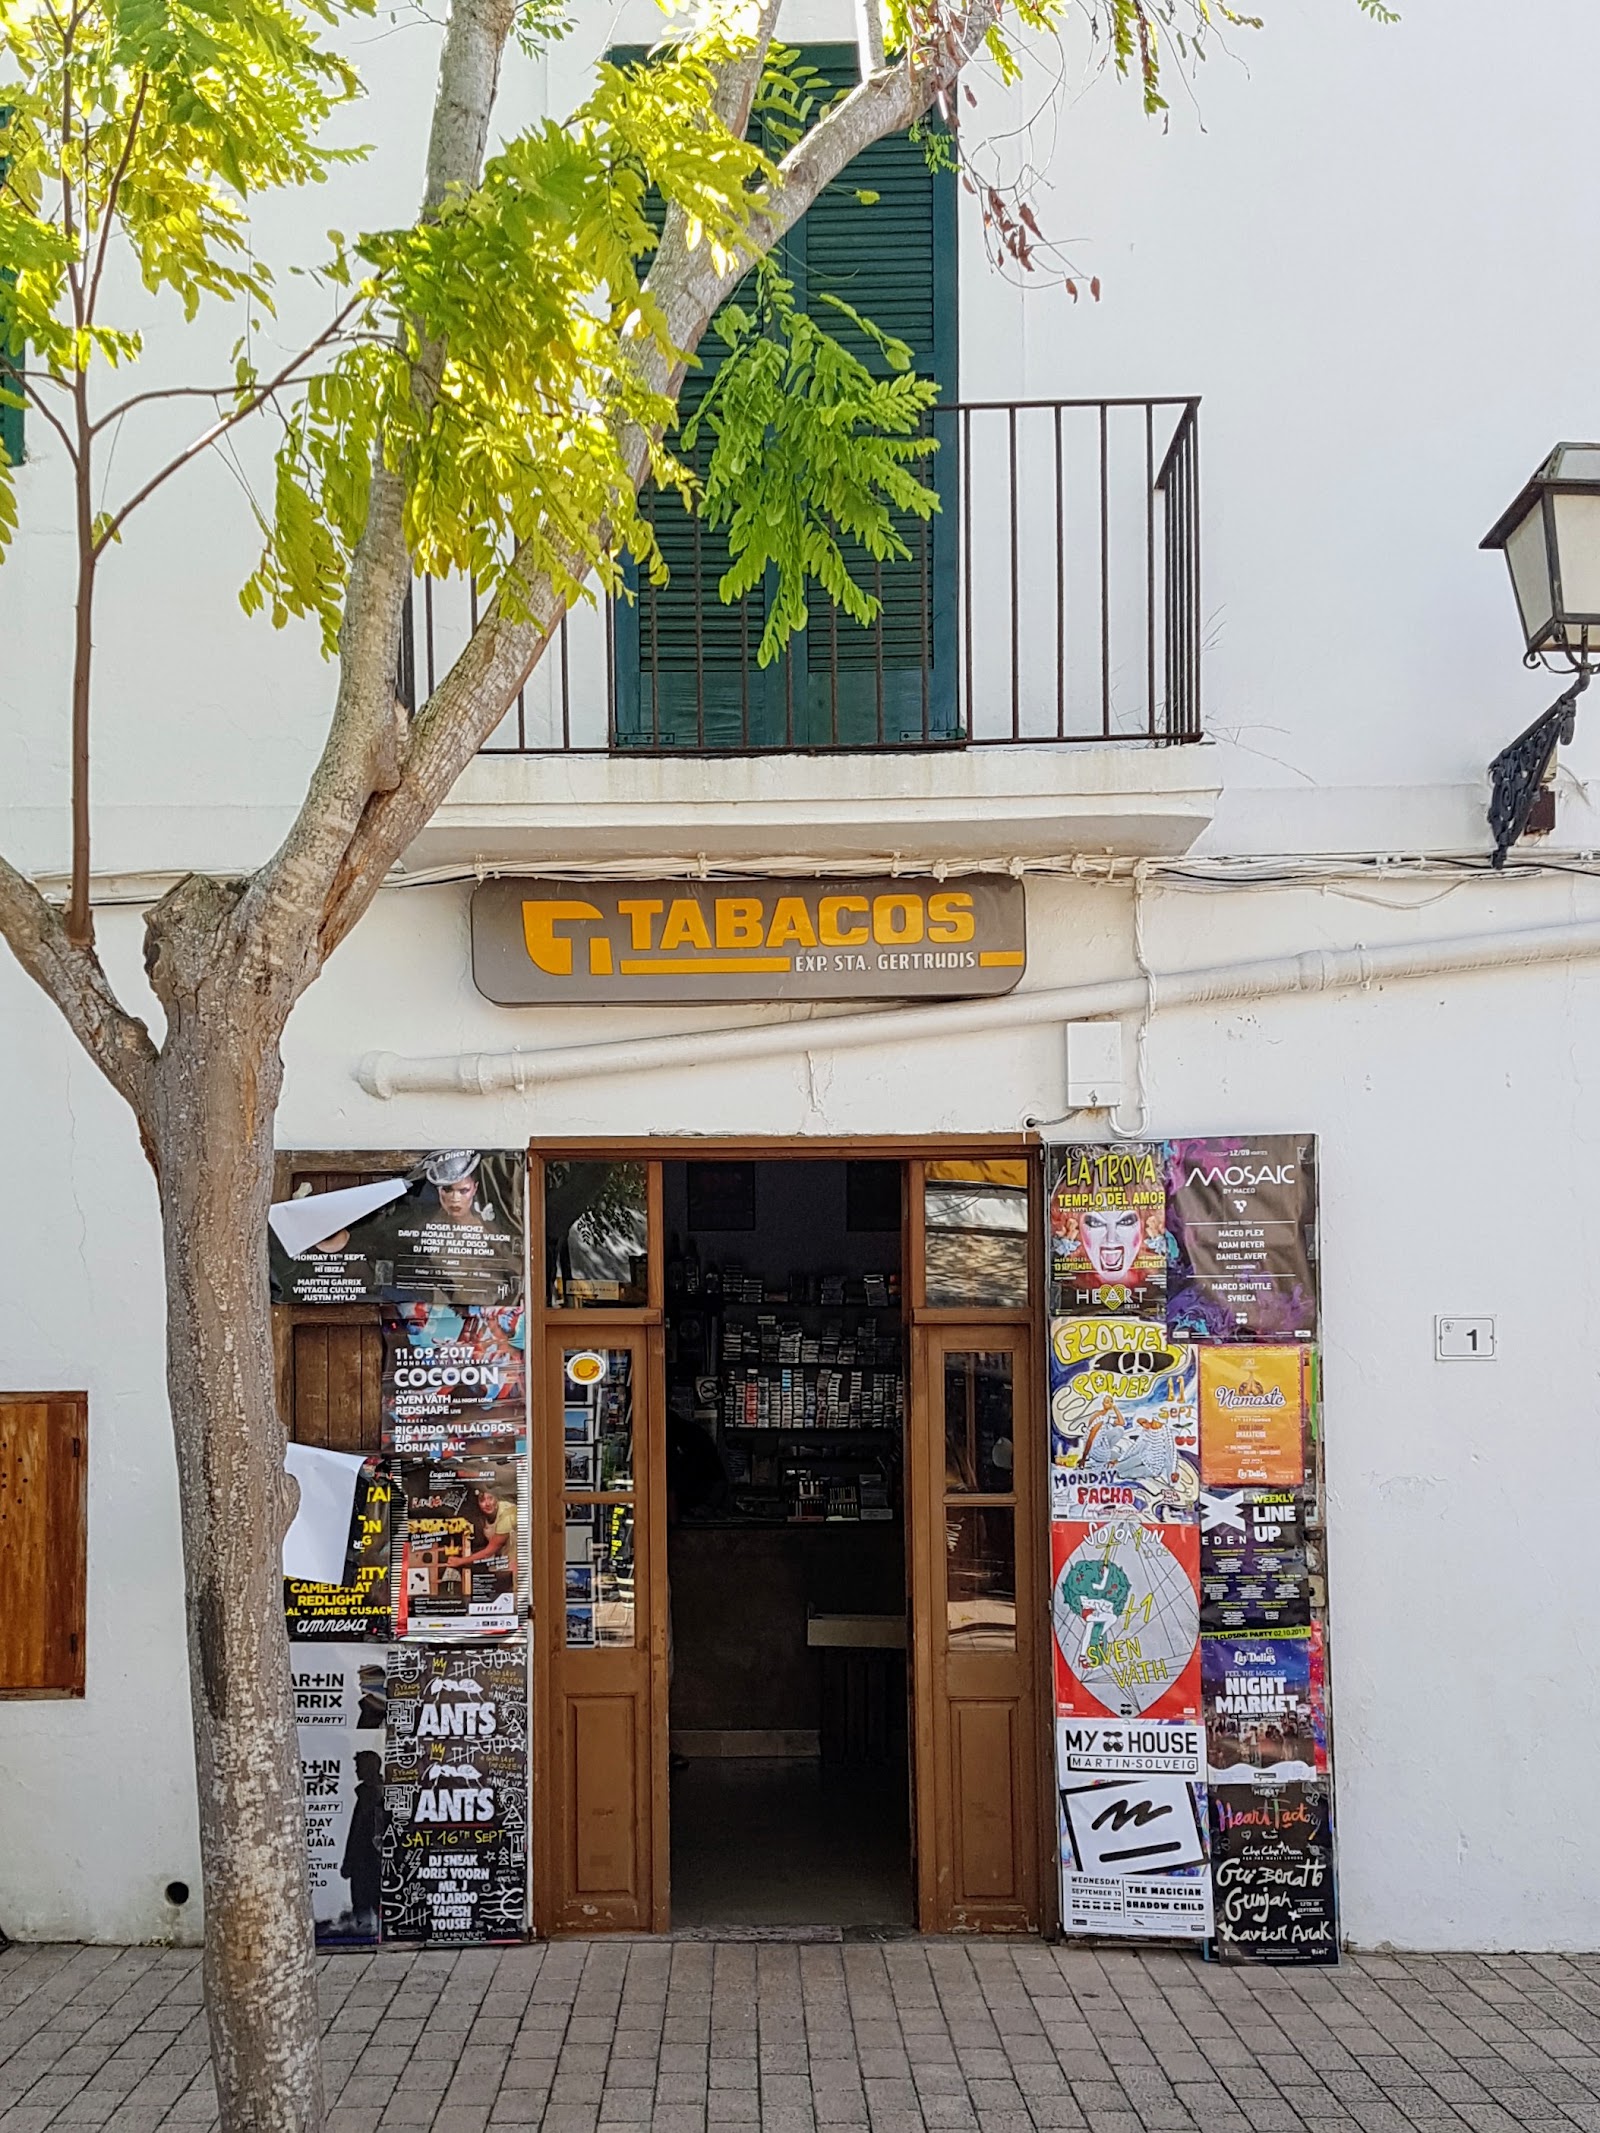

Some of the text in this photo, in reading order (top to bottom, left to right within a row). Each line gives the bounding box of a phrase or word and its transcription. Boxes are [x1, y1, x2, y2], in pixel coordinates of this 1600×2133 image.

[617, 892, 976, 951] TABACOS
[795, 951, 977, 973] EXP. STA. GERTRUDIS
[1066, 1154, 1157, 1186] LA TROYA
[1185, 1164, 1295, 1187] MOSAIC
[1057, 1191, 1166, 1207] TEMPLO DEL AMOR
[425, 1223, 484, 1233] ROGER SANCHEZ
[1218, 1229, 1244, 1237] MACEO
[421, 1231, 455, 1239] MORALES
[483, 1234, 511, 1242] WILSON
[466, 1240, 488, 1248] DISCO
[1216, 1252, 1268, 1260] DANIEL AVERY
[292, 1286, 367, 1294] VINTAGE CULTURE
[1239, 1282, 1272, 1290] SHUTTLE
[302, 1294, 332, 1302] JUSTIN
[1076, 1287, 1147, 1305] HEART
[1466, 1328, 1478, 1351] 1
[395, 1346, 475, 1360] 11.09.2017
[393, 1366, 499, 1387] COCOON
[1072, 1370, 1150, 1402] POWER
[1166, 1376, 1186, 1404] 11
[395, 1395, 425, 1405] SVEN
[425, 1391, 452, 1404] VÄTH
[1214, 1384, 1287, 1408] Namaste
[395, 1405, 449, 1415] REDSHAPE
[395, 1423, 513, 1435] RICARDO VILLALOBOS
[395, 1434, 412, 1444] ZIP
[395, 1442, 466, 1453] DORIAN PAIC
[1054, 1469, 1117, 1490] MONDAY
[1077, 1486, 1134, 1505] PACHA
[1252, 1493, 1296, 1504] WEEKLY
[1252, 1505, 1297, 1523] LINE
[1201, 1535, 1247, 1546] EDEN
[1253, 1525, 1281, 1543] UP
[297, 1594, 365, 1606] REDLIGHT
[310, 1606, 348, 1616] JAMES
[349, 1606, 392, 1615] CUSACK
[296, 1618, 368, 1633] amnesia
[1220, 1631, 1248, 1640] CLOSING
[1249, 1630, 1273, 1638] PARTY
[1086, 1636, 1143, 1668] SVEN
[1112, 1657, 1169, 1689] VÄTH
[1225, 1676, 1287, 1696] NIGHT
[296, 1694, 342, 1708] RRIX
[1215, 1695, 1299, 1714] MARKET
[312, 1716, 344, 1724] PARTY
[416, 1702, 497, 1736] ANTS
[1065, 1729, 1198, 1754] MY HOUSE
[306, 1781, 339, 1796] RIX
[308, 1803, 340, 1812] PARTY
[414, 1788, 495, 1823] ANTS
[1215, 1799, 1273, 1832] Heart
[306, 1828, 325, 1837] PT.
[401, 1830, 434, 1848] SAT.
[307, 1834, 336, 1847] UAÏA
[428, 1854, 479, 1867] DJ SNEAK
[416, 1868, 448, 1880] JORIS
[450, 1868, 490, 1880] VOORN
[1071, 1876, 1120, 1886] WEDNESDAY
[461, 1880, 468, 1892] J
[1071, 1888, 1112, 1897] SEPTEMBER
[1128, 1886, 1202, 1896] THE MAGICIAN
[426, 1891, 479, 1906] SOLARDO
[1126, 1900, 1205, 1911] SHADOW CHILD
[432, 1905, 472, 1918] TAPESH
[430, 1918, 473, 1931] YOUSEF
[1216, 1921, 1288, 1943] Xavier
